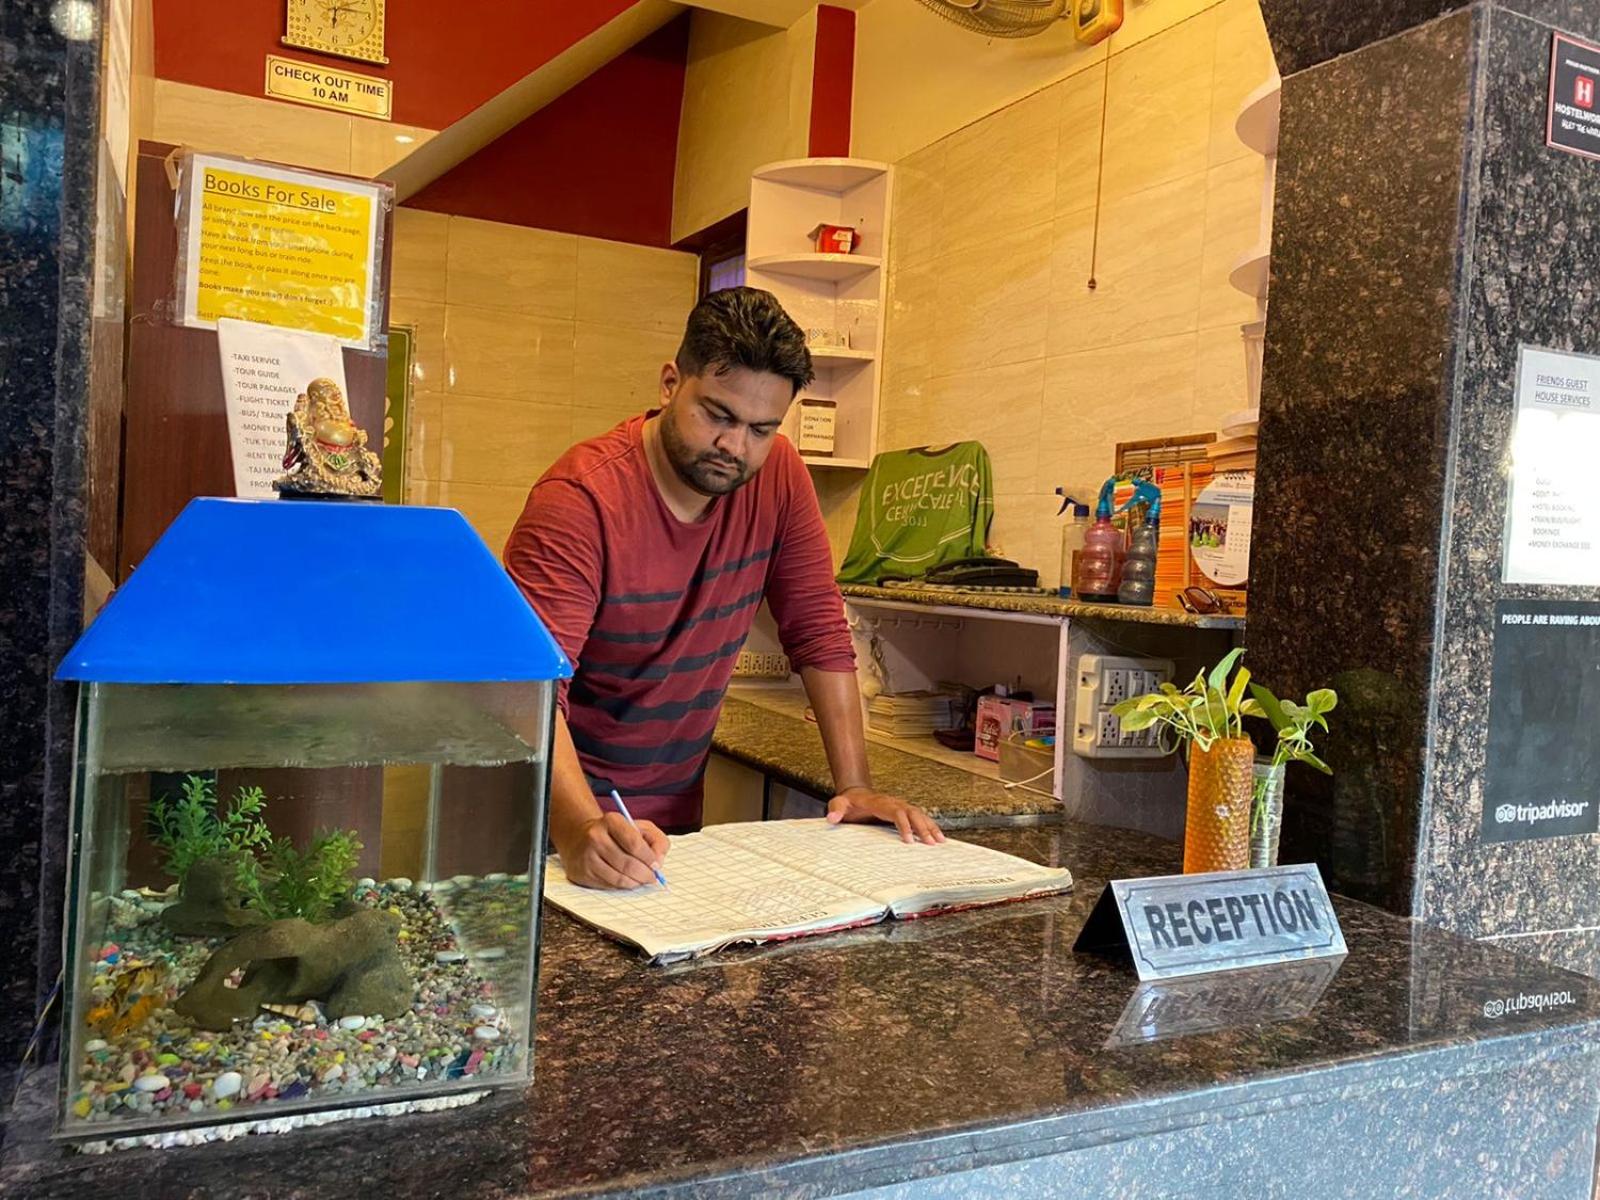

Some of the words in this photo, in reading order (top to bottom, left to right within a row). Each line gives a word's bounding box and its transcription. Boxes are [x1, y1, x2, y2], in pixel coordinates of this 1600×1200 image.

[274, 65, 321, 84] CHECK
[324, 75, 352, 90] OUT
[355, 81, 385, 98] TIME
[312, 87, 326, 99] 10
[329, 90, 349, 103] AM
[1555, 102, 1600, 124] HOSTELWOR
[205, 174, 260, 199] Books
[266, 185, 295, 204] For
[300, 191, 336, 211] Sale
[313, 220, 324, 228] the
[251, 237, 269, 245] from
[237, 246, 253, 256] long
[255, 248, 268, 257] bus
[266, 265, 281, 273] pass
[199, 281, 221, 290] Books
[223, 285, 244, 293] make
[246, 288, 260, 296] you
[304, 295, 327, 305] forget
[251, 355, 280, 365] SERVICE
[257, 369, 280, 379] GUIDE
[1535, 374, 1565, 386] FRIENDS
[1566, 378, 1588, 389] GUEST
[259, 383, 297, 394] PACKAGES
[1535, 390, 1559, 402] HOUSE
[1560, 393, 1591, 405] SERVICES
[261, 410, 284, 419] TRAIN
[262, 438, 277, 446] TUK
[1502, 613, 1532, 625] PEOPLE
[1532, 614, 1549, 625] ARE
[1549, 614, 1579, 626] RAVING
[1579, 615, 1600, 626] ABOU
[1517, 799, 1586, 825] tripadvisor
[1144, 888, 1321, 950] RECEPTION
